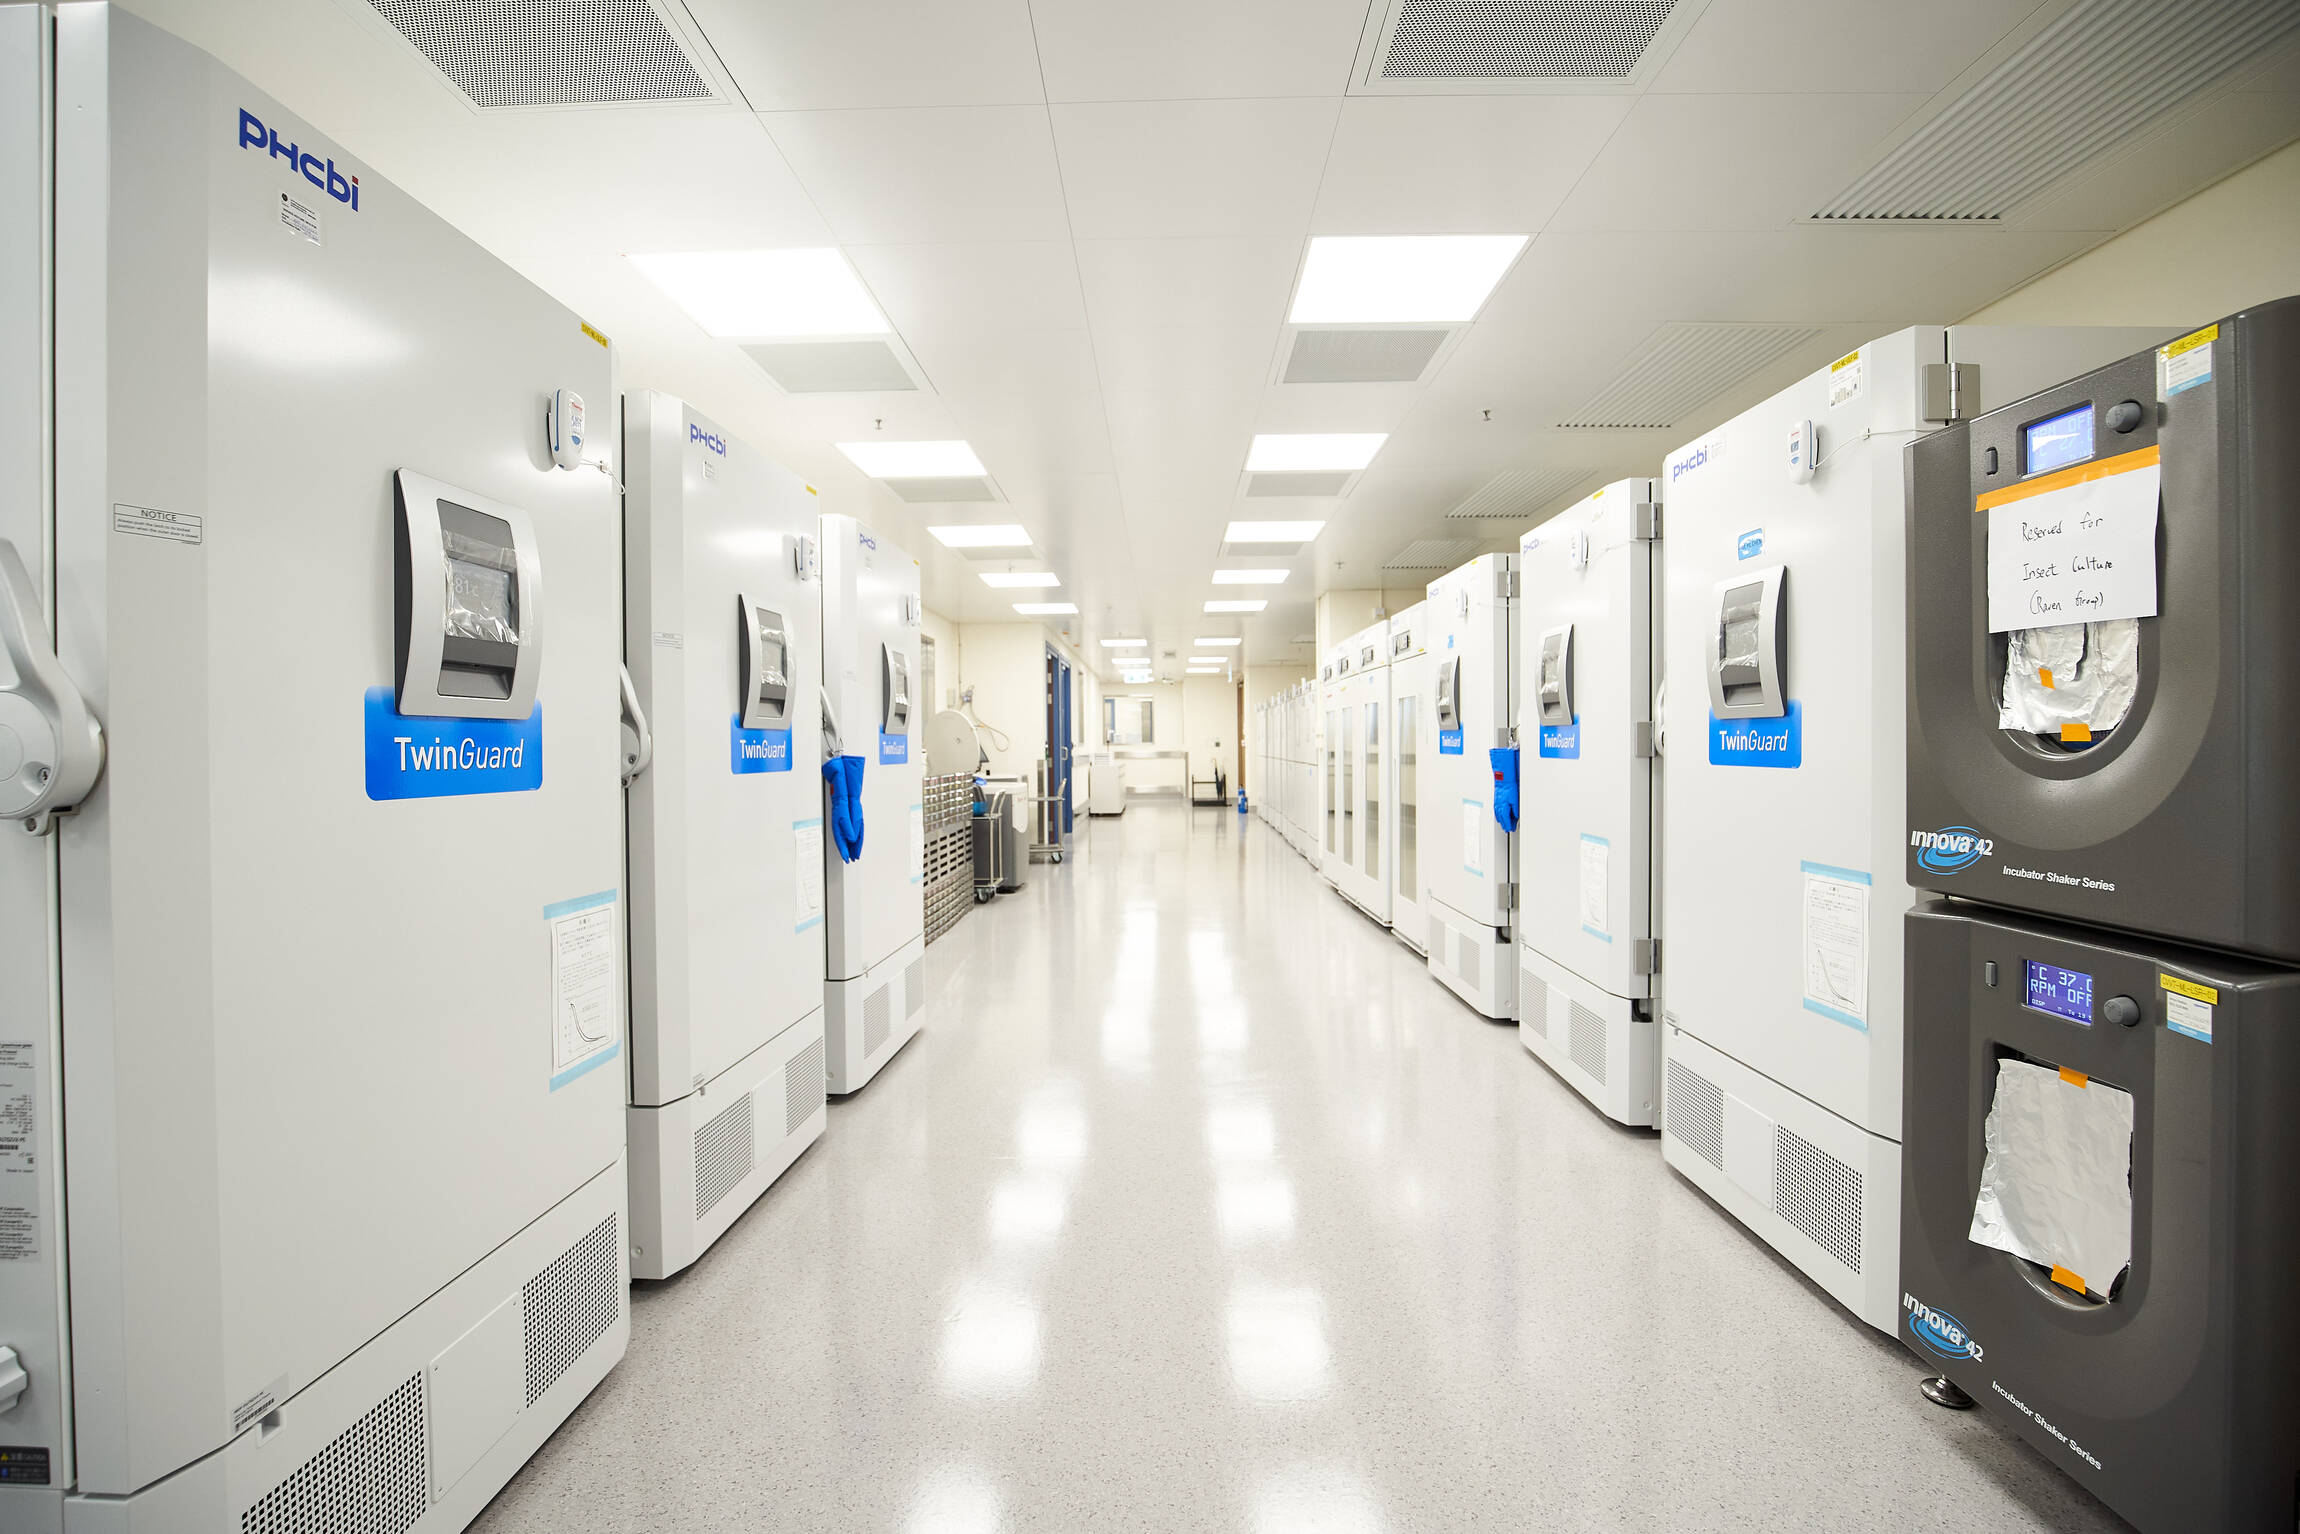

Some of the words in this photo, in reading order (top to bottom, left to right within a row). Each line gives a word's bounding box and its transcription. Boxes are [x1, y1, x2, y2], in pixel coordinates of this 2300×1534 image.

[140, 509, 177, 522] NOTICE
[2022, 520, 2062, 541] Reserved
[2080, 511, 2103, 529] for
[2022, 562, 2059, 581] Insect
[2072, 556, 2113, 572] Culture
[2030, 590, 2062, 614] (Raven
[740, 739, 786, 759] TwinGuard
[1544, 734, 1575, 749] TwinGuard
[1719, 729, 1788, 752] TwinGuard
[394, 737, 524, 771] TwinGuard
[1911, 830, 1971, 853] innova
[1975, 838, 1994, 856] 42
[2002, 865, 2046, 882] Incubator
[2046, 871, 2081, 887] Shaker
[2082, 877, 2116, 892] Series
[2030, 979, 2056, 998] RPM
[2068, 989, 2092, 1007] OFF
[1903, 1292, 1963, 1346] innova
[1966, 1339, 1984, 1363] 42
[1992, 1380, 2034, 1418] Incubator
[2034, 1413, 2068, 1444] Shaker
[2069, 1439, 2102, 1471] Series
